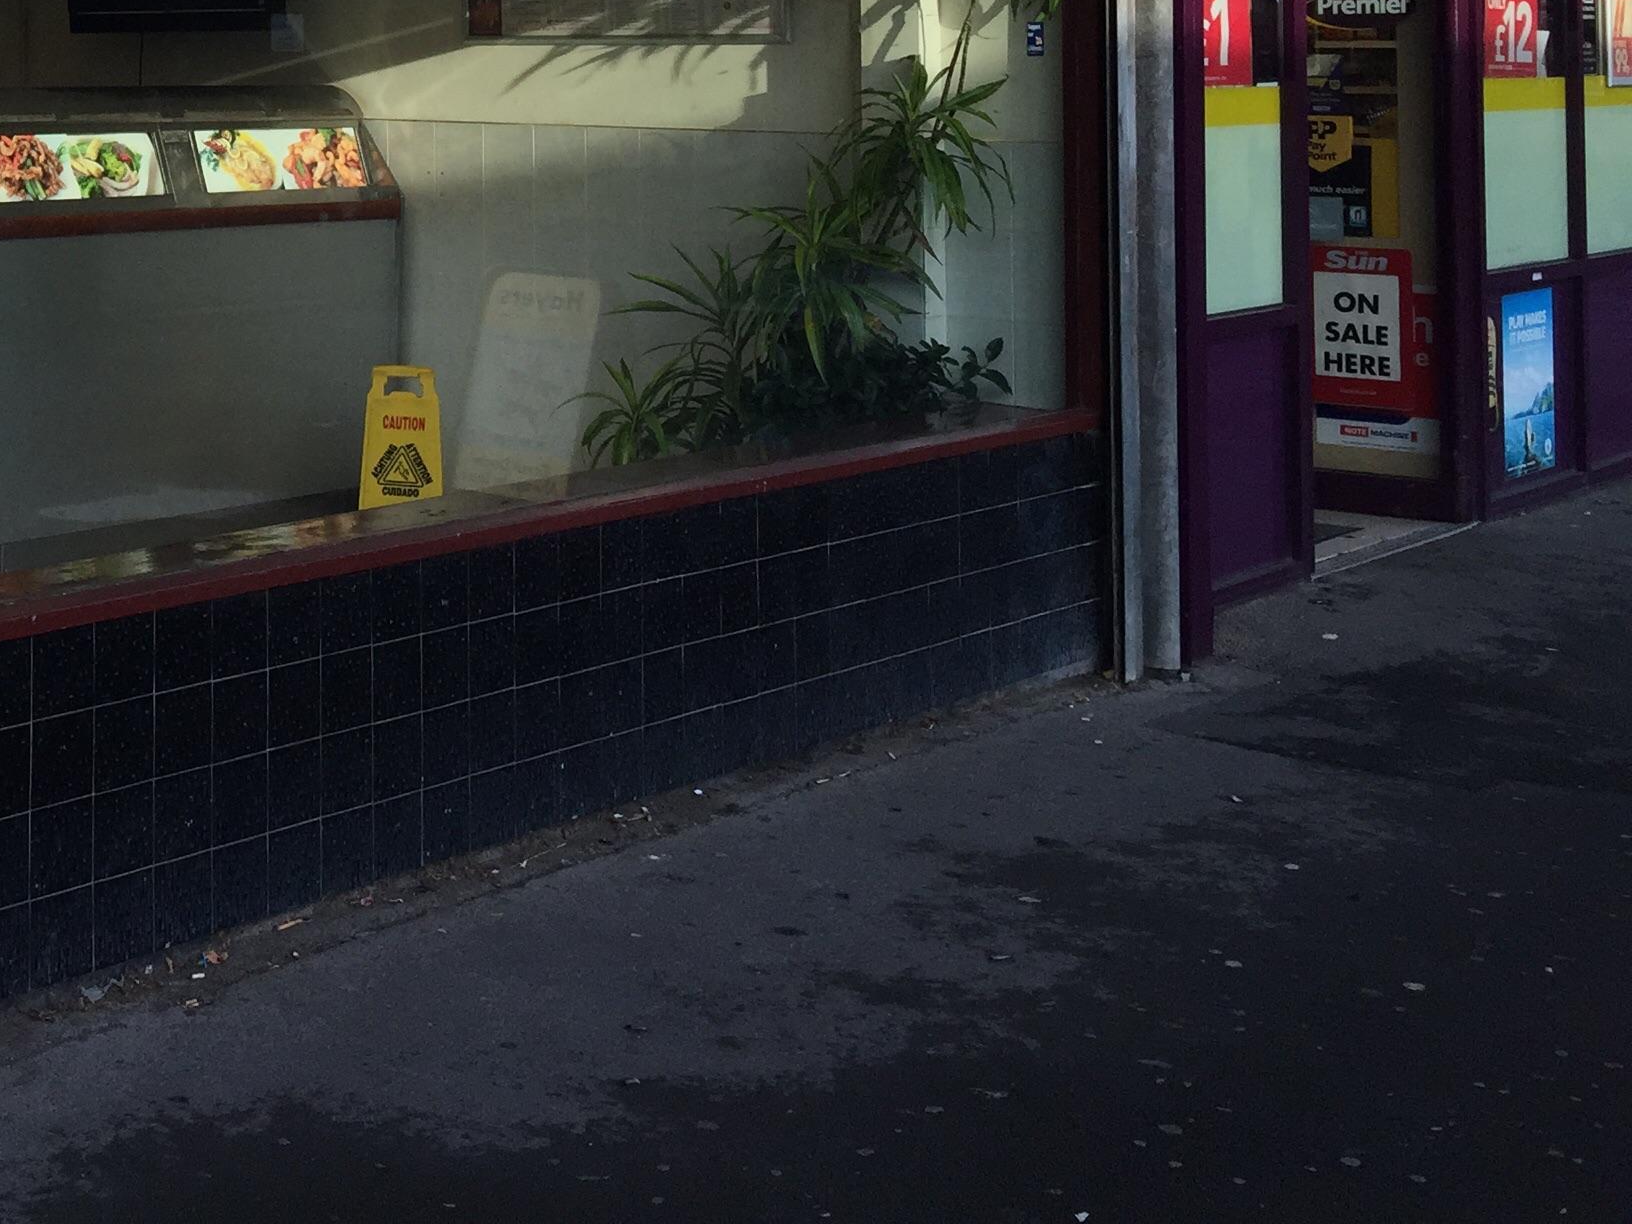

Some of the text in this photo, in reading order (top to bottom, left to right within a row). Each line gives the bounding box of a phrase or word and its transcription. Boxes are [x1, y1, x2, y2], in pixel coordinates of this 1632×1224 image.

[1494, 0, 1533, 63] £12
[1324, 249, 1388, 271] Sun
[1333, 291, 1380, 315] ON
[1325, 321, 1389, 346] SALE
[1323, 351, 1391, 377] HERE
[383, 414, 426, 431] CAUTION
[371, 443, 398, 479] ACHTUNG
[405, 443, 433, 486] ATTENTION
[382, 487, 419, 498] CUIDADO
